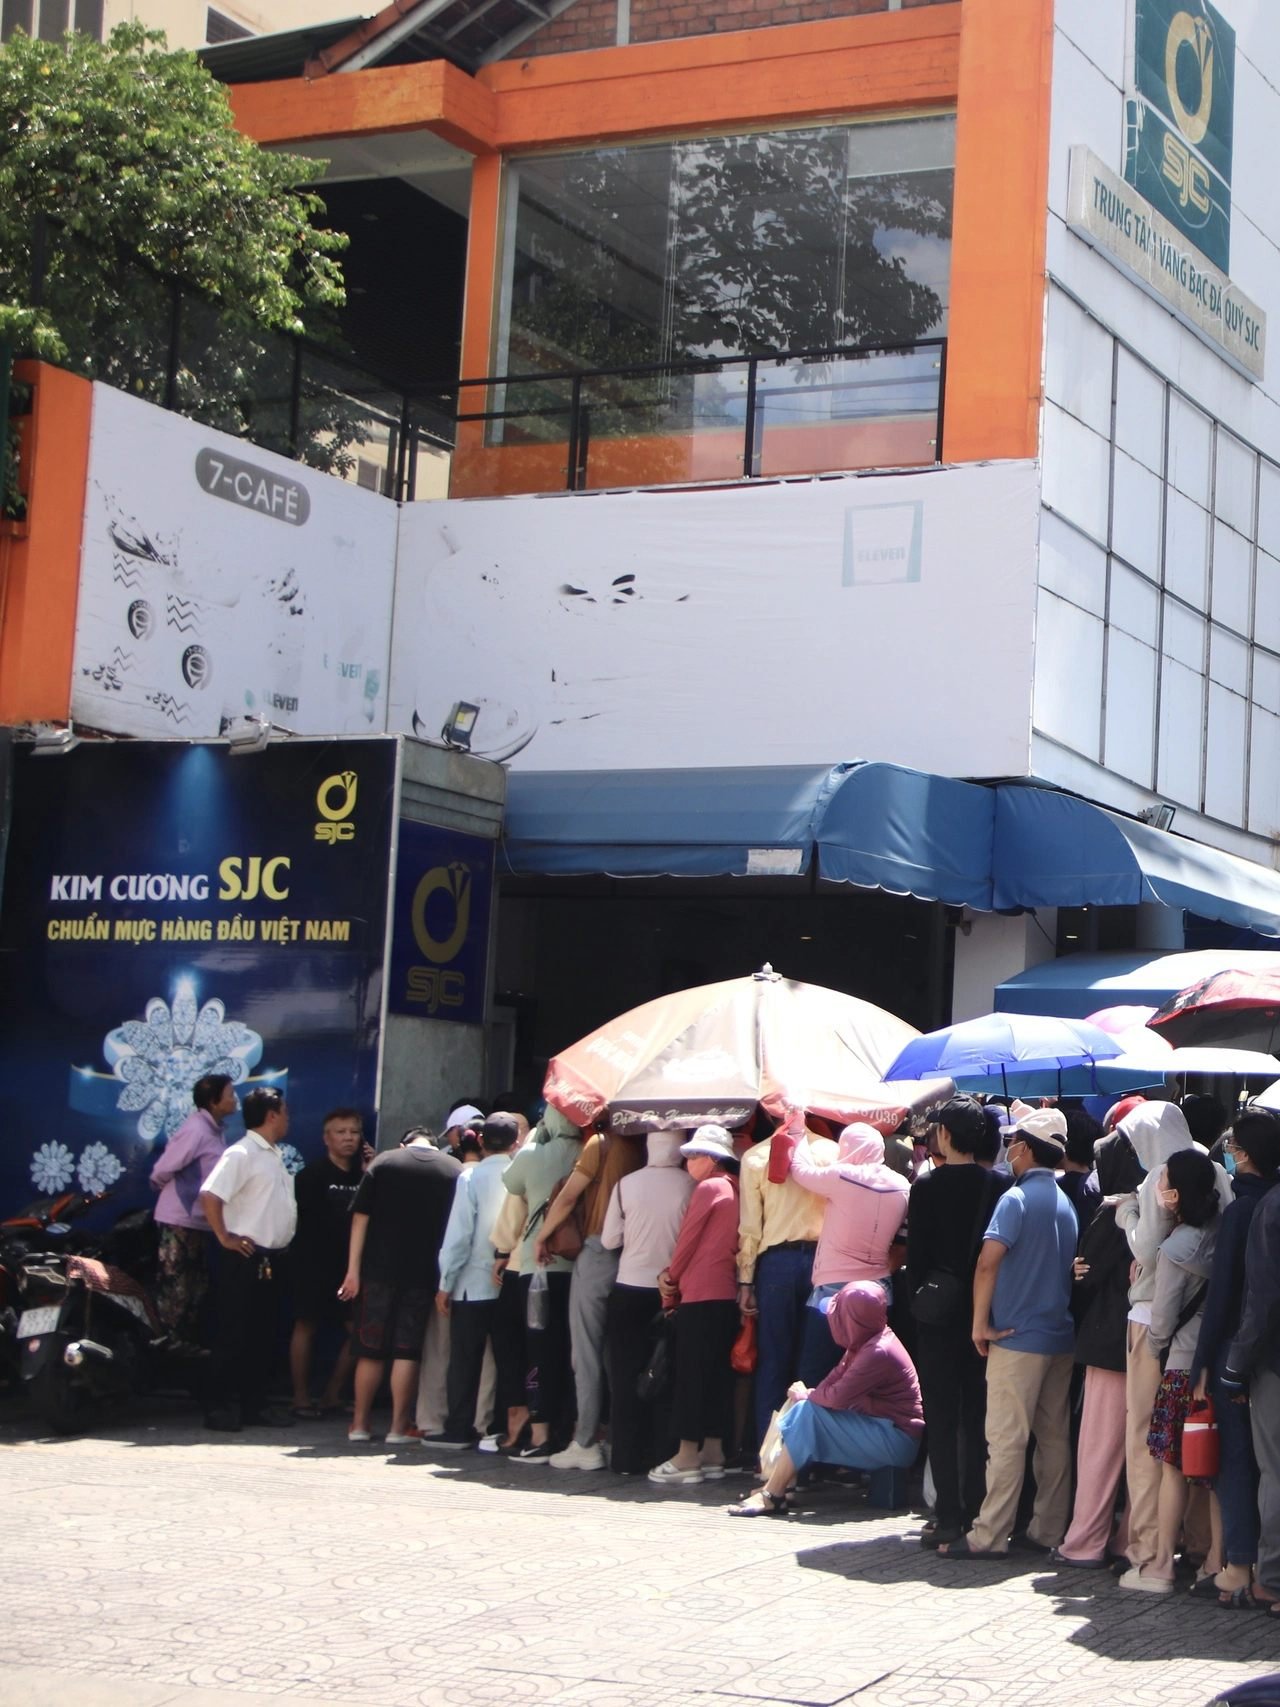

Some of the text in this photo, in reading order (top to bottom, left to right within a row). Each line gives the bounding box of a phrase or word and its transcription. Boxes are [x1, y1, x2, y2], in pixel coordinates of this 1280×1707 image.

[1093, 176, 1260, 352] TRUNG TÂM VÀNG BẠC ĐÁ QUÝ SJC
[208, 459, 299, 520] 7-CAFÉ
[314, 822, 355, 845] SJC
[50, 856, 291, 901] KIM CƯƠNG SJC
[47, 911, 350, 945] CHUẨN MỰC HÀNG ĐẦU VIỆT NAM
[406, 966, 466, 1014] SJC
